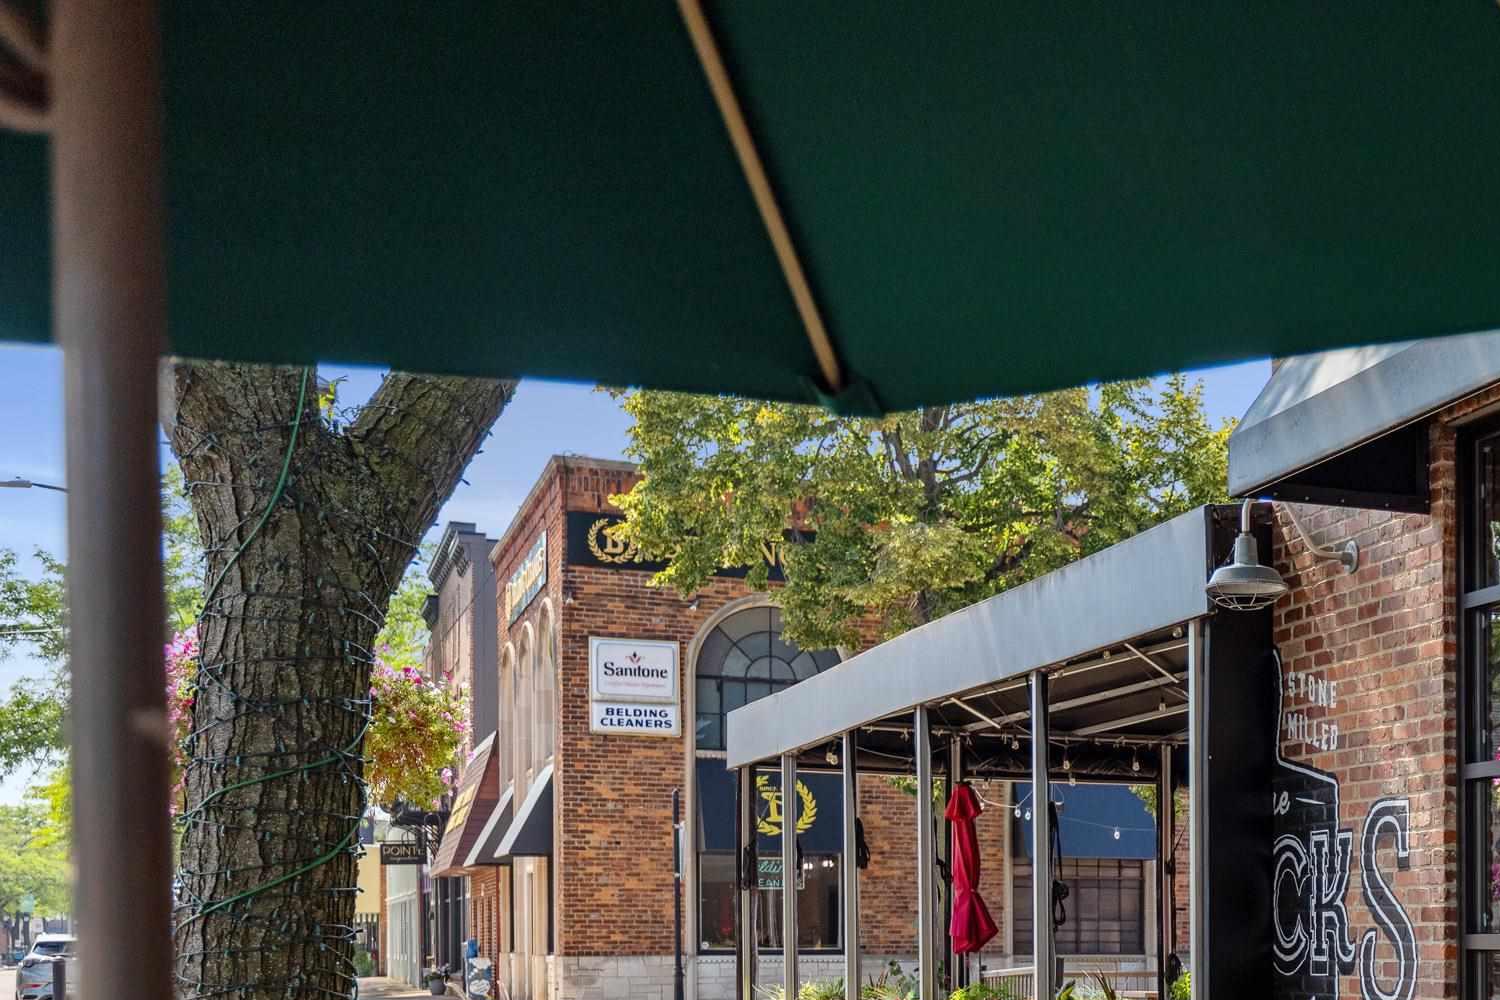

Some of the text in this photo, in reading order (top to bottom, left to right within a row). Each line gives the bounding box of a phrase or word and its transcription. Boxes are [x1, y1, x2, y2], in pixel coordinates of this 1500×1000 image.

[604, 661, 668, 679] Sanitone
[1288, 672, 1336, 708] STONE
[606, 707, 669, 718] BELDING
[600, 717, 672, 729] CLEANERS
[1287, 713, 1338, 750] MILLED
